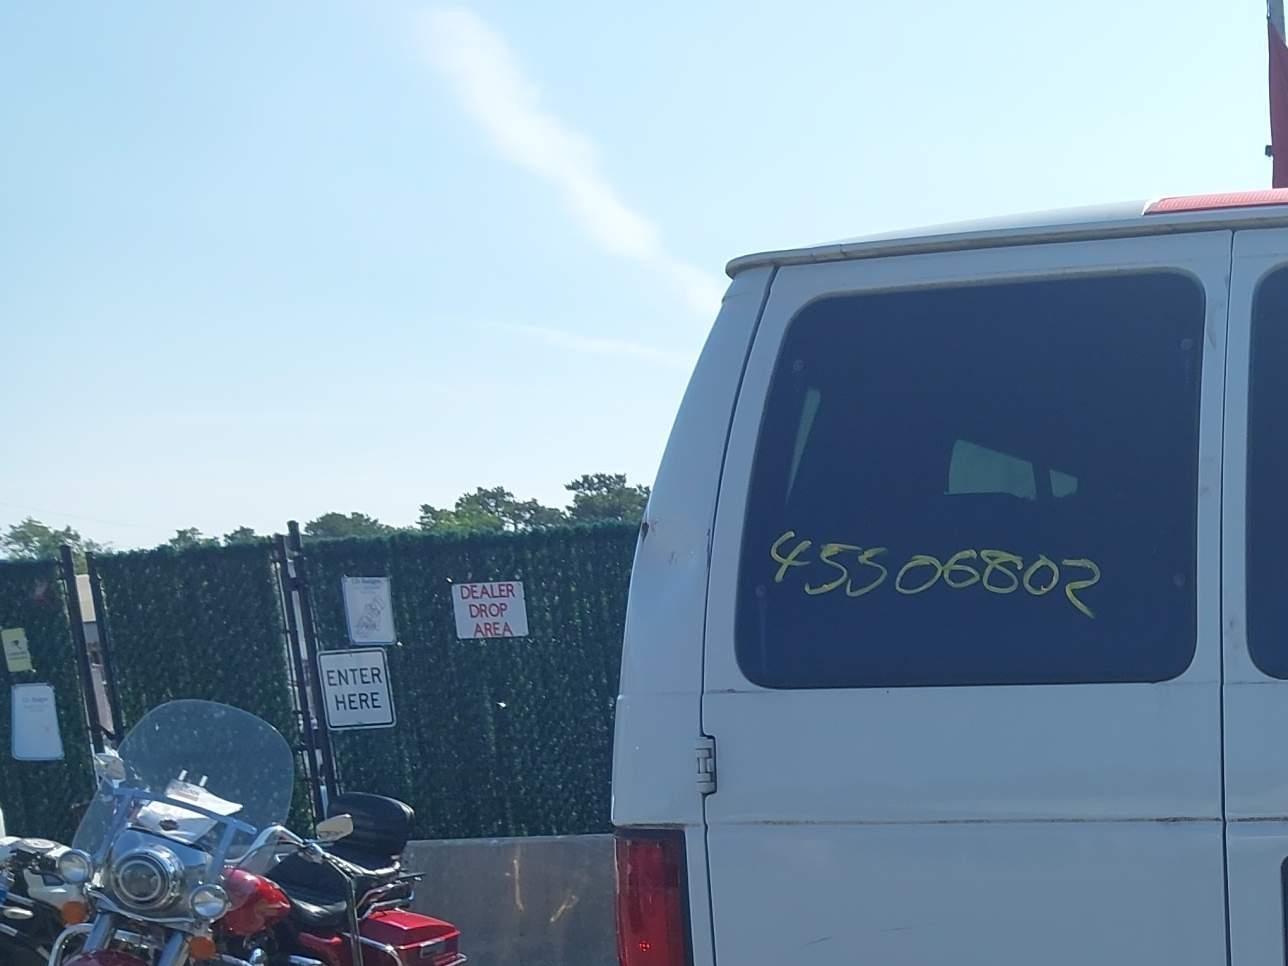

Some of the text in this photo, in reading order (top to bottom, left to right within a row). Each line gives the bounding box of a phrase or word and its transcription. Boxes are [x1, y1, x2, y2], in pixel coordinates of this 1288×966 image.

[770, 531, 1101, 619] 45506802
[460, 583, 516, 600] DEALER
[468, 603, 509, 618] DROP
[473, 621, 514, 637] AREA
[326, 667, 383, 686] ENTER
[334, 692, 382, 711] HERE
